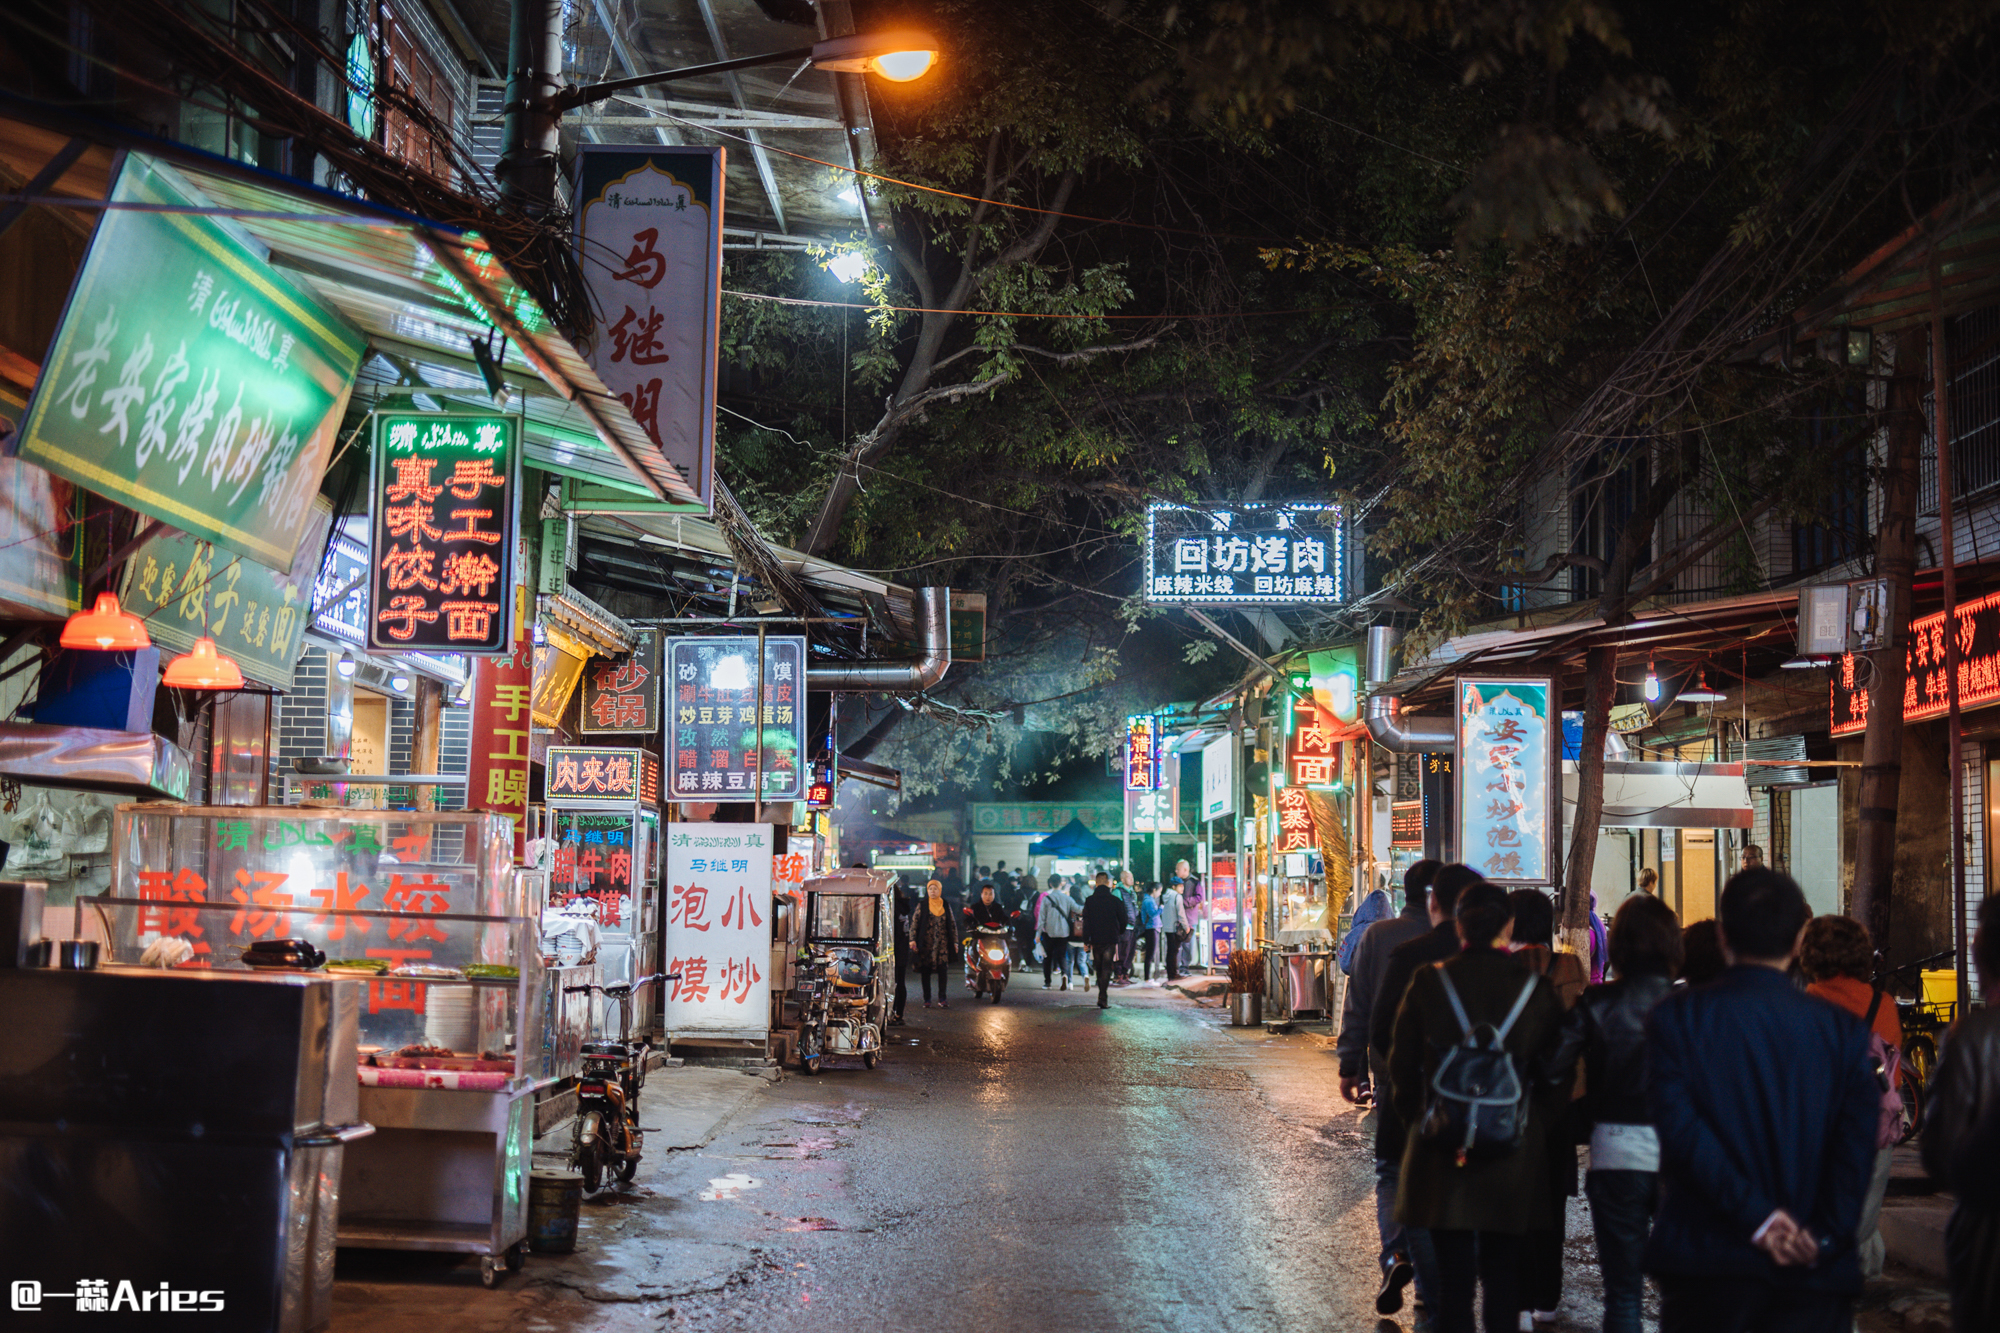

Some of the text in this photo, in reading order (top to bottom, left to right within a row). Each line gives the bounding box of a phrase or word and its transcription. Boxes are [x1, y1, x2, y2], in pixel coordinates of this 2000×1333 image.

[188, 271, 213, 316] 清
[55, 303, 323, 532] 老安家烤肉砂锅店
[378, 453, 444, 640] 真味饺子
[439, 458, 505, 641] 手工擀面
[1175, 536, 1325, 573] 回坊烤肉
[1154, 575, 1334, 595] 麻辣米线 回坊麻辣
[679, 662, 792, 681] 砂馍
[591, 659, 650, 727] 砂锅
[679, 706, 793, 724] 炒豆芽 鸡蛋汤
[679, 728, 792, 747] 孜然
[552, 754, 634, 793] 肉夹馍
[678, 771, 794, 791] 麻辣豆腐干
[1483, 718, 1528, 876] 安家小炒泡馍
[218, 821, 254, 851] 清
[345, 824, 384, 855] 真
[563, 829, 624, 846] 马继明
[1278, 788, 1311, 851] 粉蒸肉
[671, 833, 692, 847] 清
[744, 833, 765, 848] 真
[552, 847, 631, 885] 腊牛肉
[690, 858, 748, 873] 马继明
[137, 867, 450, 943] 酸汤水饺
[670, 881, 711, 1004] 泡馍
[720, 885, 763, 1005] 小炒
